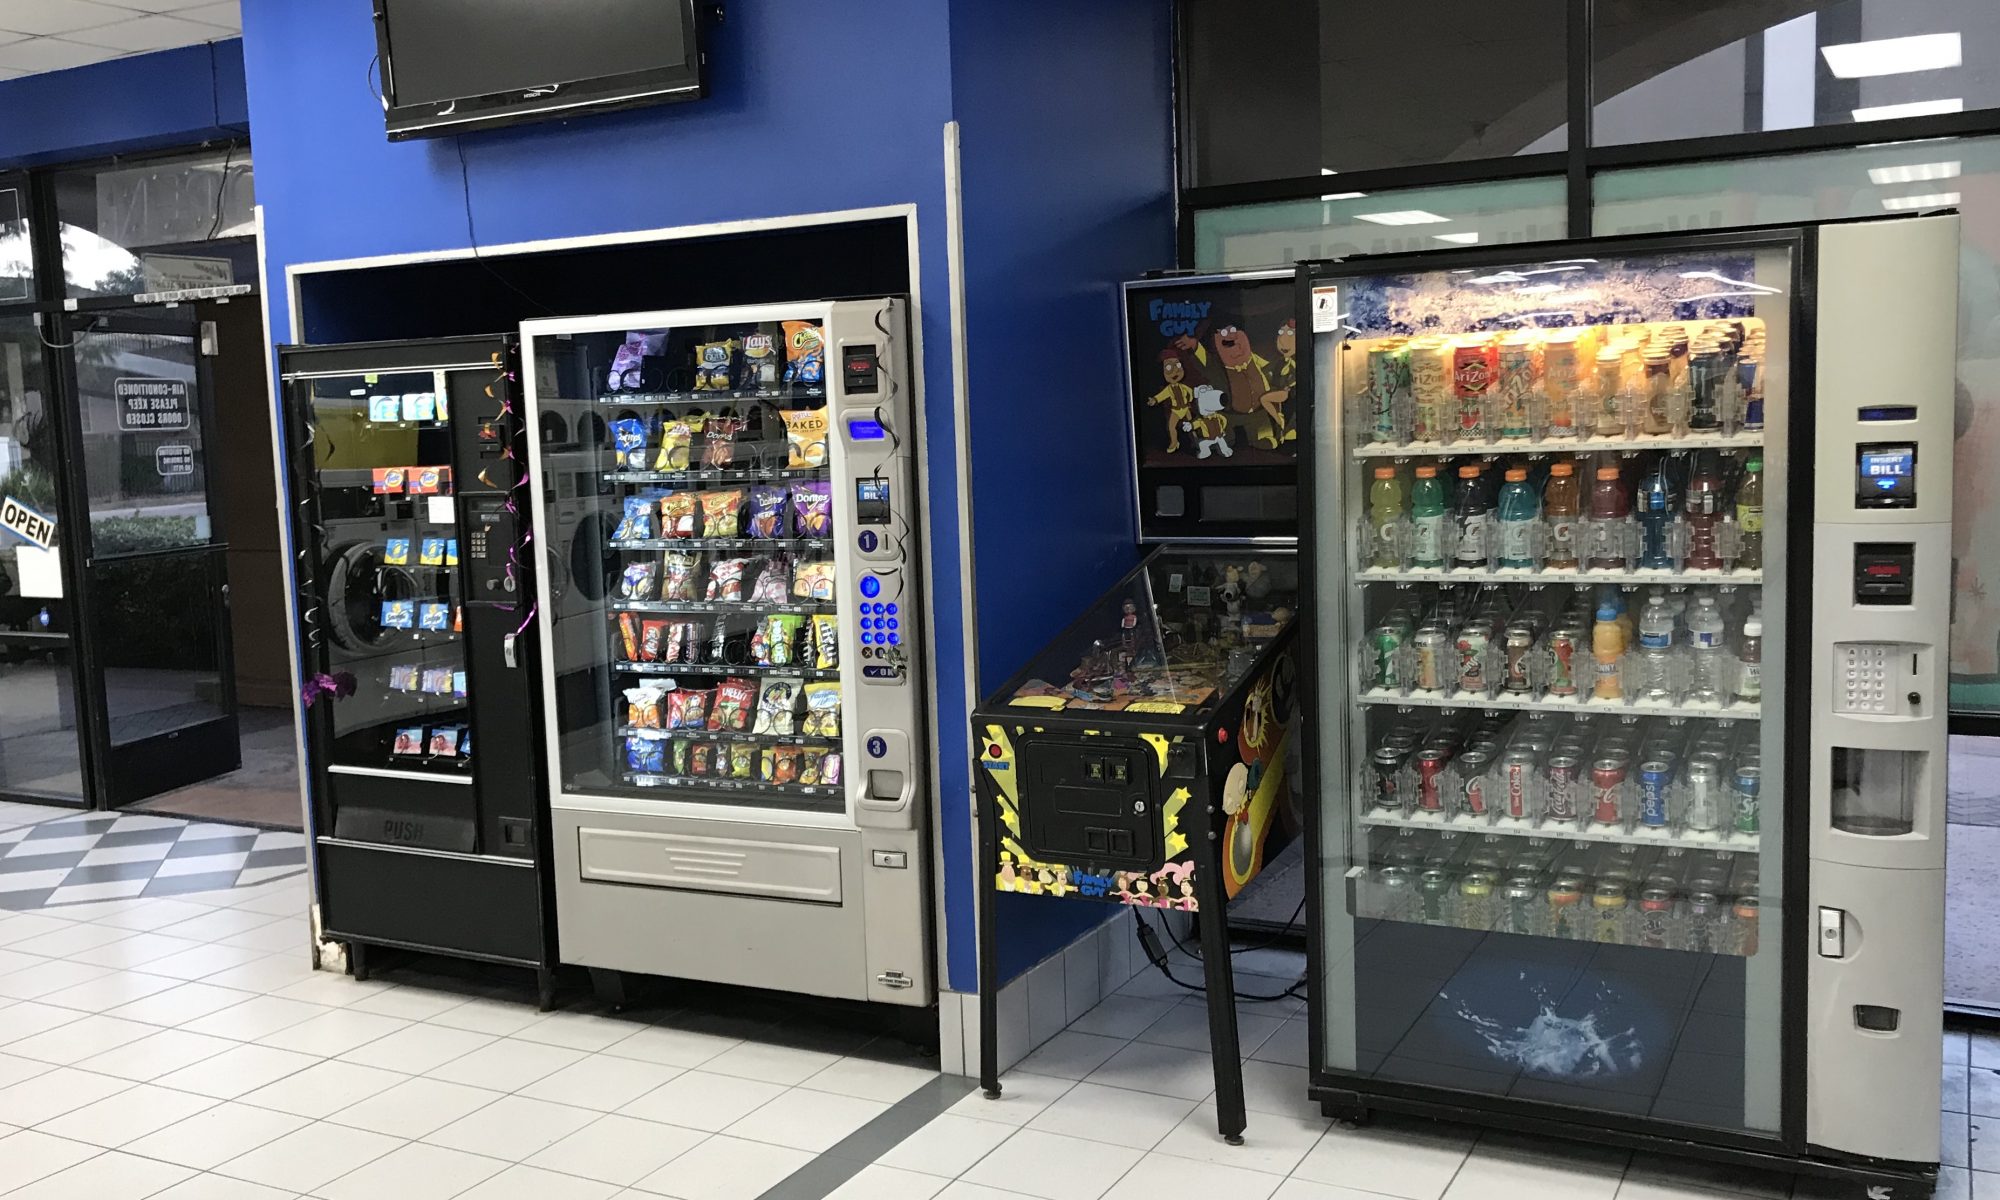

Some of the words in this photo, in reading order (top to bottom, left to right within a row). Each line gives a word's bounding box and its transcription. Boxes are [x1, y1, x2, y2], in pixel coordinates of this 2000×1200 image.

[1160, 320, 1199, 337] GUY
[786, 419, 823, 429] BAKED
[1870, 464, 1904, 475] BILL
[387, 473, 401, 484] Tide
[422, 473, 436, 484] Tide
[796, 493, 829, 503] Doritos
[4, 504, 51, 544] OPEN
[1553, 522, 1570, 541] G
[863, 534, 870, 549] 1
[880, 668, 894, 677] OK
[1597, 663, 1616, 673] NNY
[871, 739, 882, 756] 3
[983, 761, 1009, 770] START
[1647, 781, 1658, 817] pepsi
[384, 820, 424, 841] PUSH
